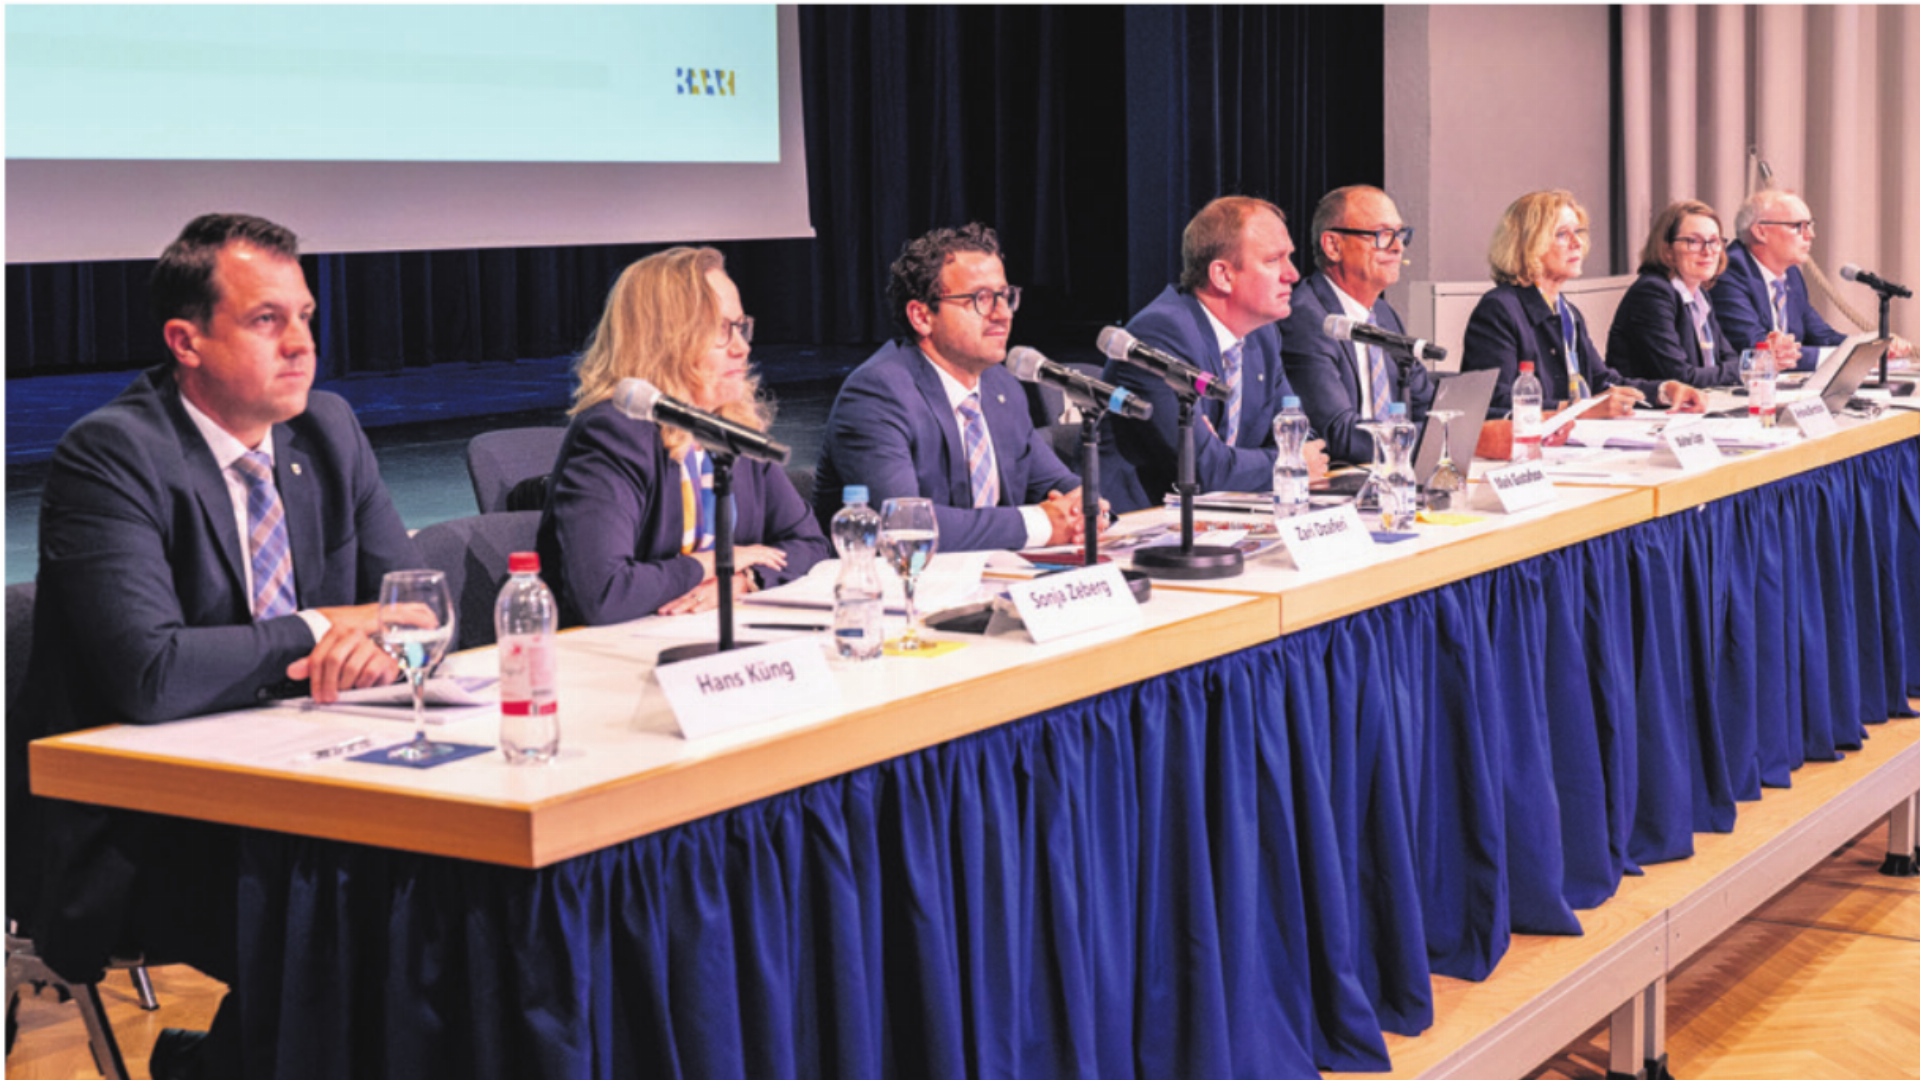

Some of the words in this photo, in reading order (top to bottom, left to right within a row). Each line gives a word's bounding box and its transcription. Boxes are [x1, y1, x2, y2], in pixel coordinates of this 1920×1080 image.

[1029, 587, 1067, 609] Sonja
[1064, 579, 1112, 600] Zeberg
[696, 671, 745, 695] Hans
[744, 660, 796, 683] Küng
